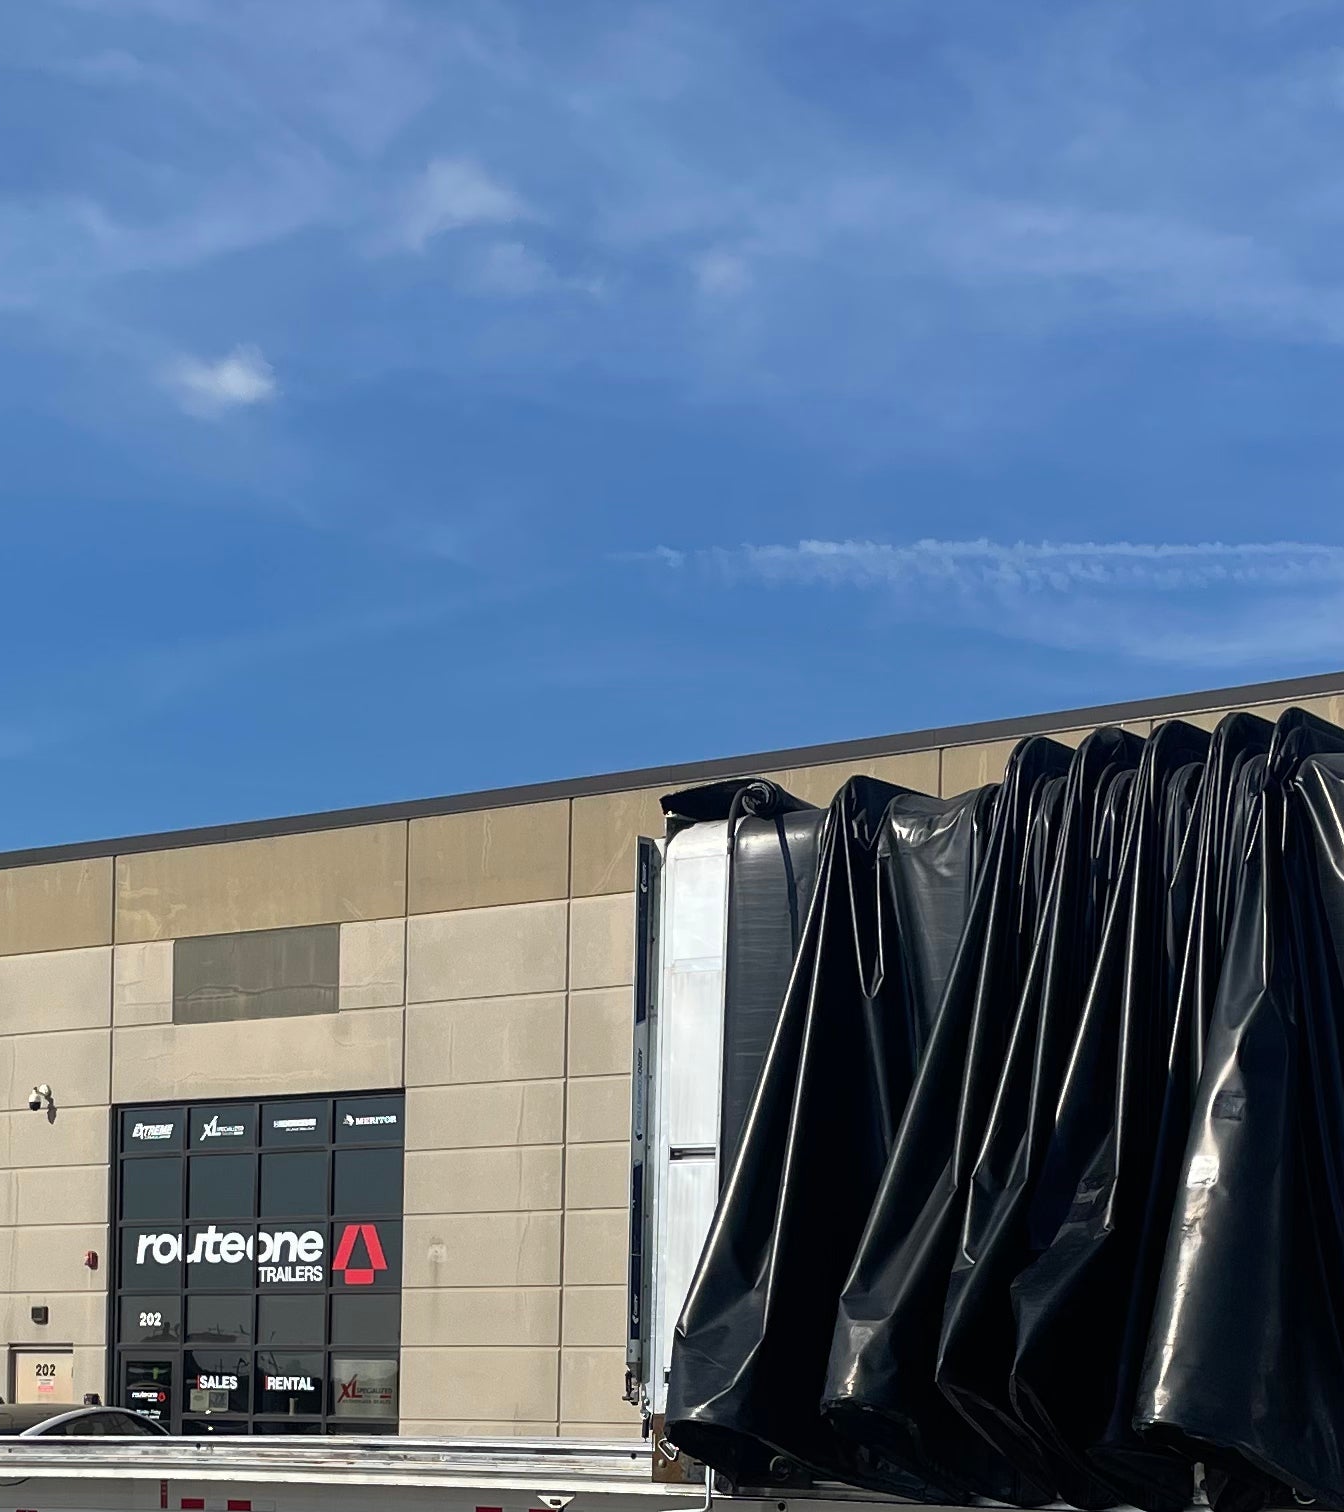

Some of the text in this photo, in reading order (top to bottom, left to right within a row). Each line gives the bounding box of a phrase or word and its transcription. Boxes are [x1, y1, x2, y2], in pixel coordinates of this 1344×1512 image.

[355, 1115, 397, 1126] MERITOR
[136, 1225, 324, 1265] routeone
[258, 1265, 323, 1283] TRAILERS
[139, 1312, 162, 1327] 202
[35, 1363, 56, 1376] 202
[199, 1375, 238, 1390] SALES
[267, 1376, 315, 1391] RENTAL
